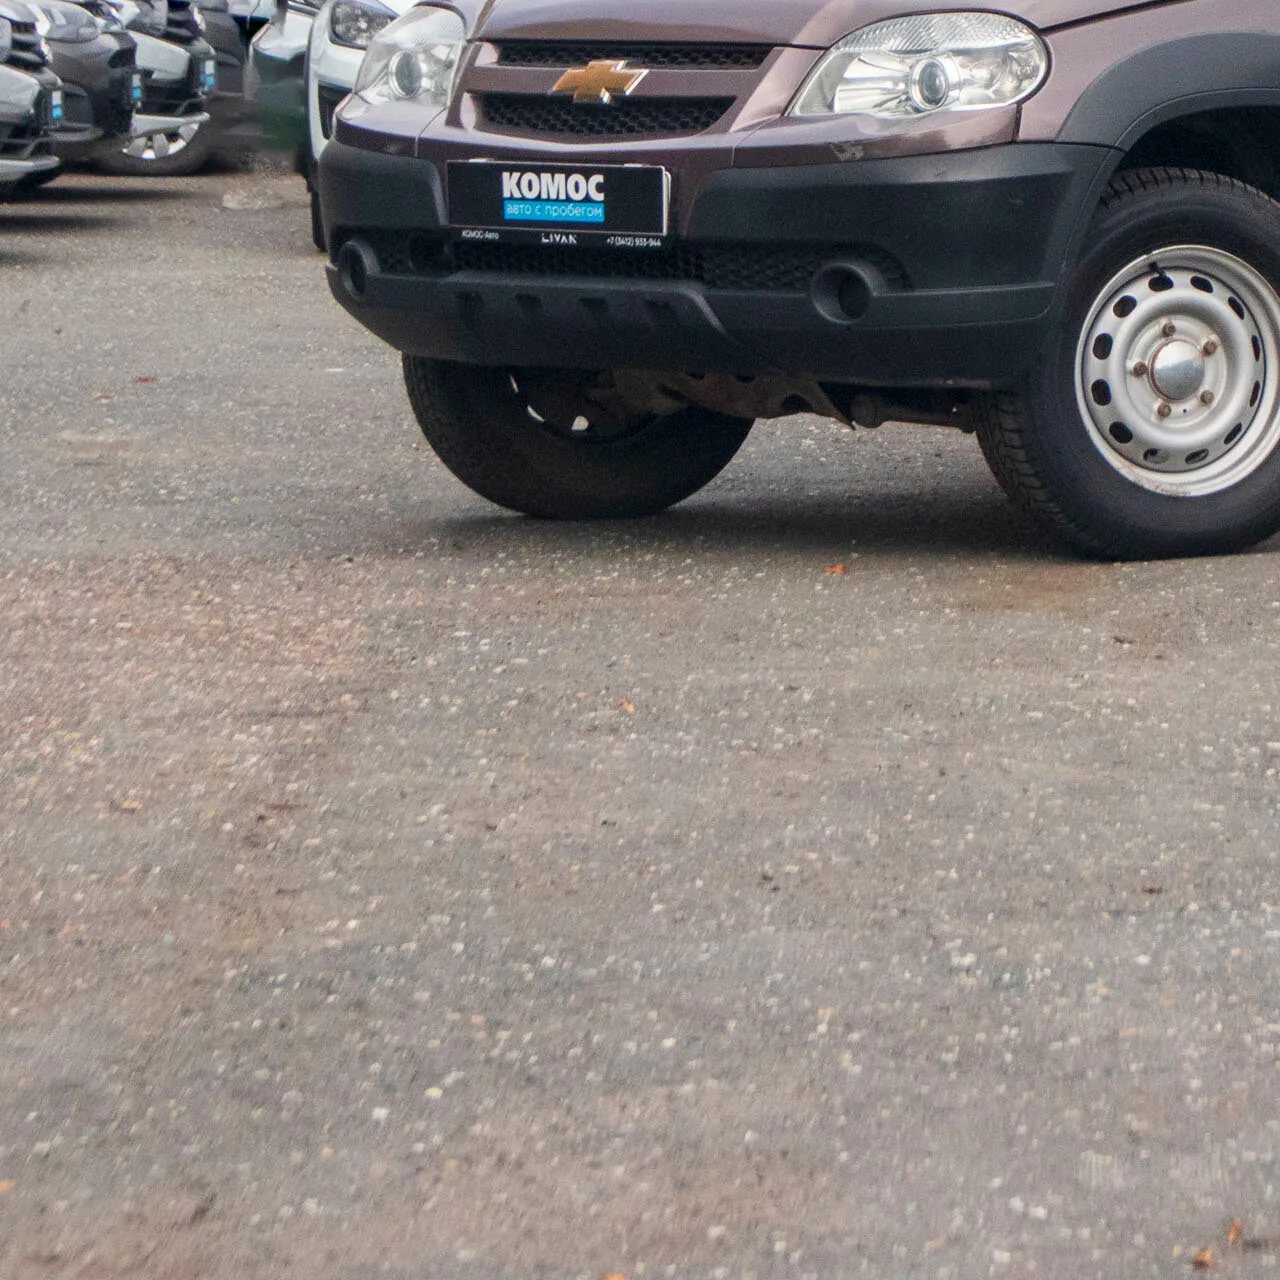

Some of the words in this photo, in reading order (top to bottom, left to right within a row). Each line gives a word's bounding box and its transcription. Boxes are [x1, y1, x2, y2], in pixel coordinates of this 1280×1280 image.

[502, 171, 605, 202] КОМОС
[507, 204, 532, 215] авто
[535, 206, 541, 215] с
[544, 203, 603, 217] пробегом
